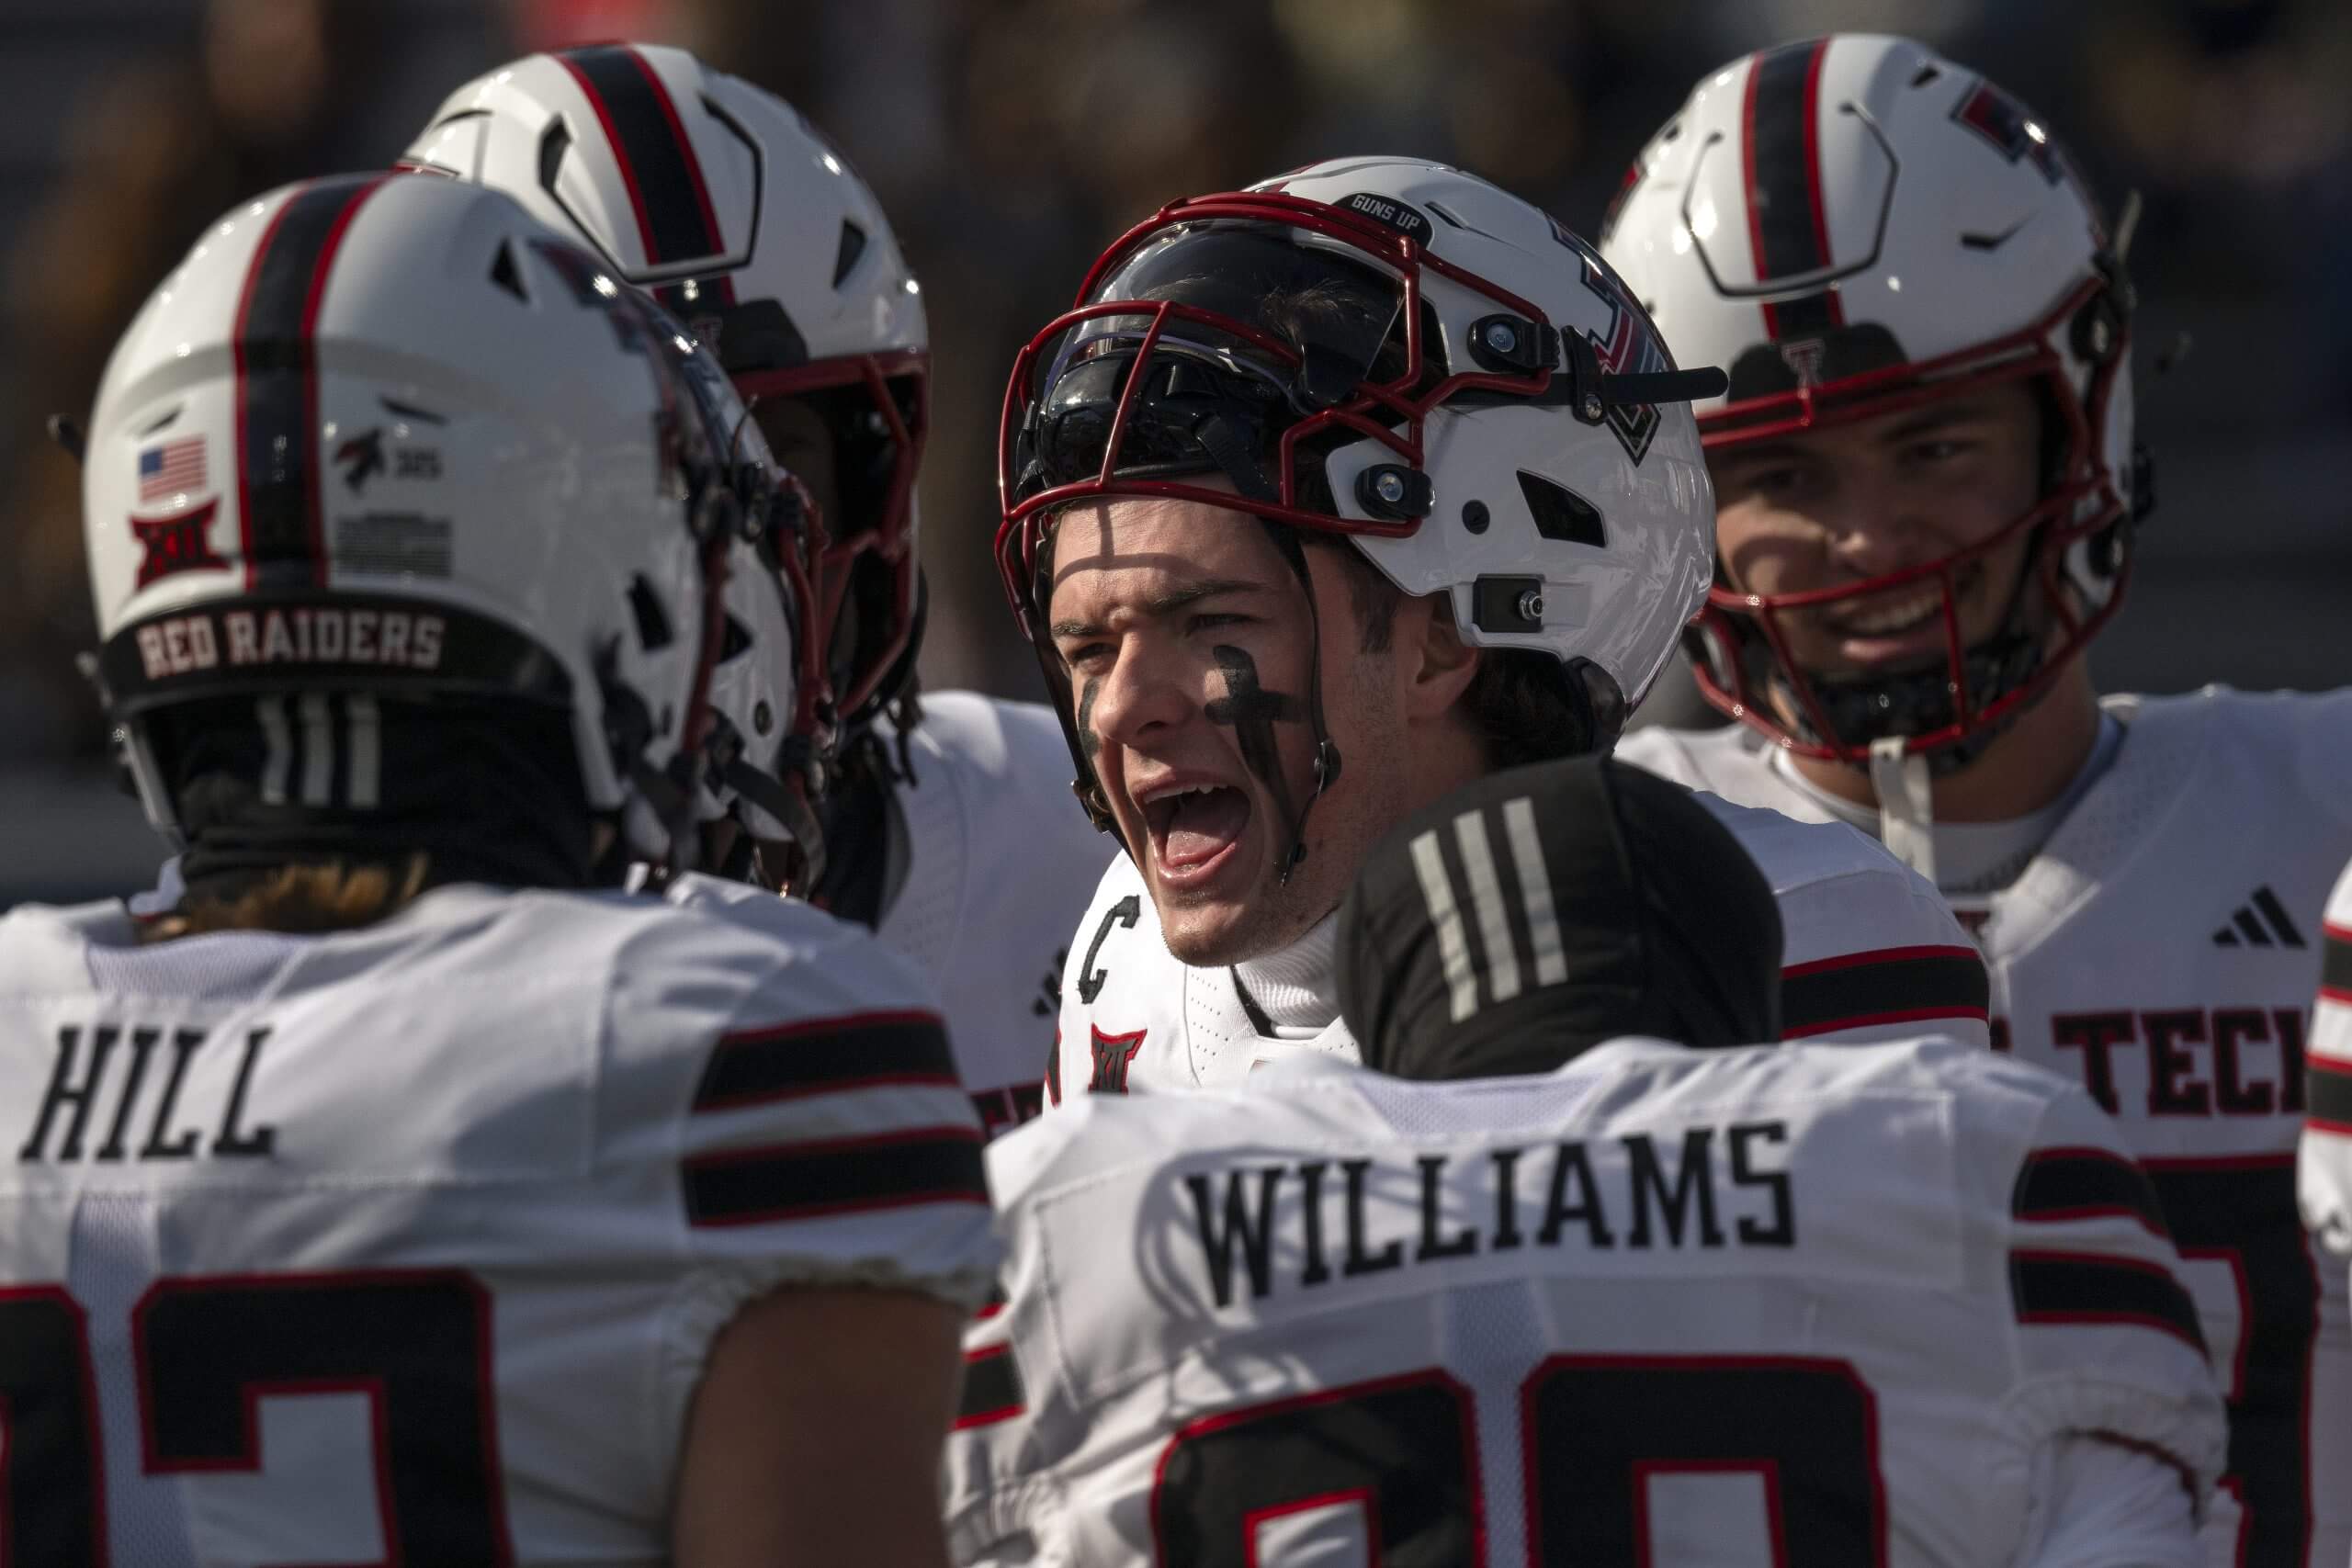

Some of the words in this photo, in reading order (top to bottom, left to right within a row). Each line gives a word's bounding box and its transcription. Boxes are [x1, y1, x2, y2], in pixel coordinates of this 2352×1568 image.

[1351, 194, 1396, 220] GUNS
[1396, 211, 1420, 230] UP
[138, 615, 220, 681] RED
[224, 609, 446, 671] RAIDERS
[1078, 895, 1140, 1005] C
[17, 1024, 278, 1162] HILL
[1183, 1120, 1797, 1310] WILLIAMS
